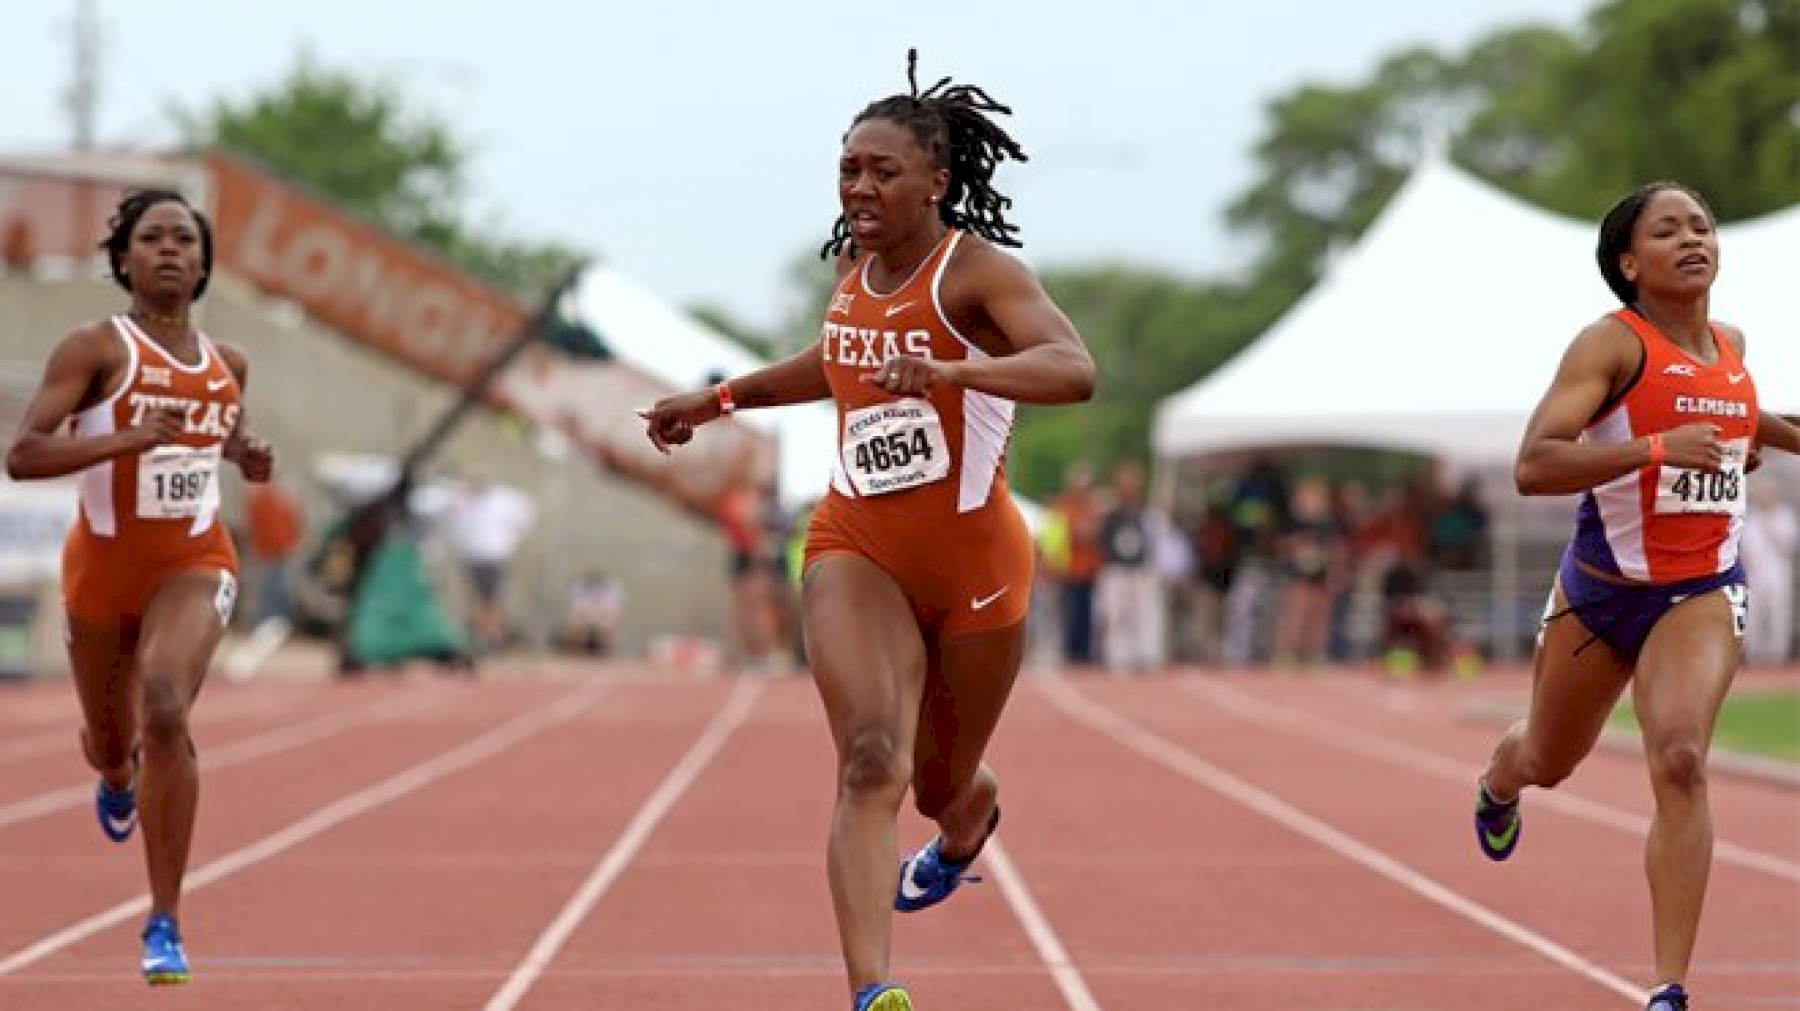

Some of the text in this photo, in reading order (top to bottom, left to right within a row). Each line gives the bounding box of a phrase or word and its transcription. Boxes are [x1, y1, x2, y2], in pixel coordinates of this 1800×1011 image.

[822, 320, 932, 366] TEXAS
[1674, 395, 1748, 418] CLEMSON
[855, 427, 934, 475] 4654
[152, 469, 212, 502] 1997
[1671, 466, 1739, 502] 4103
